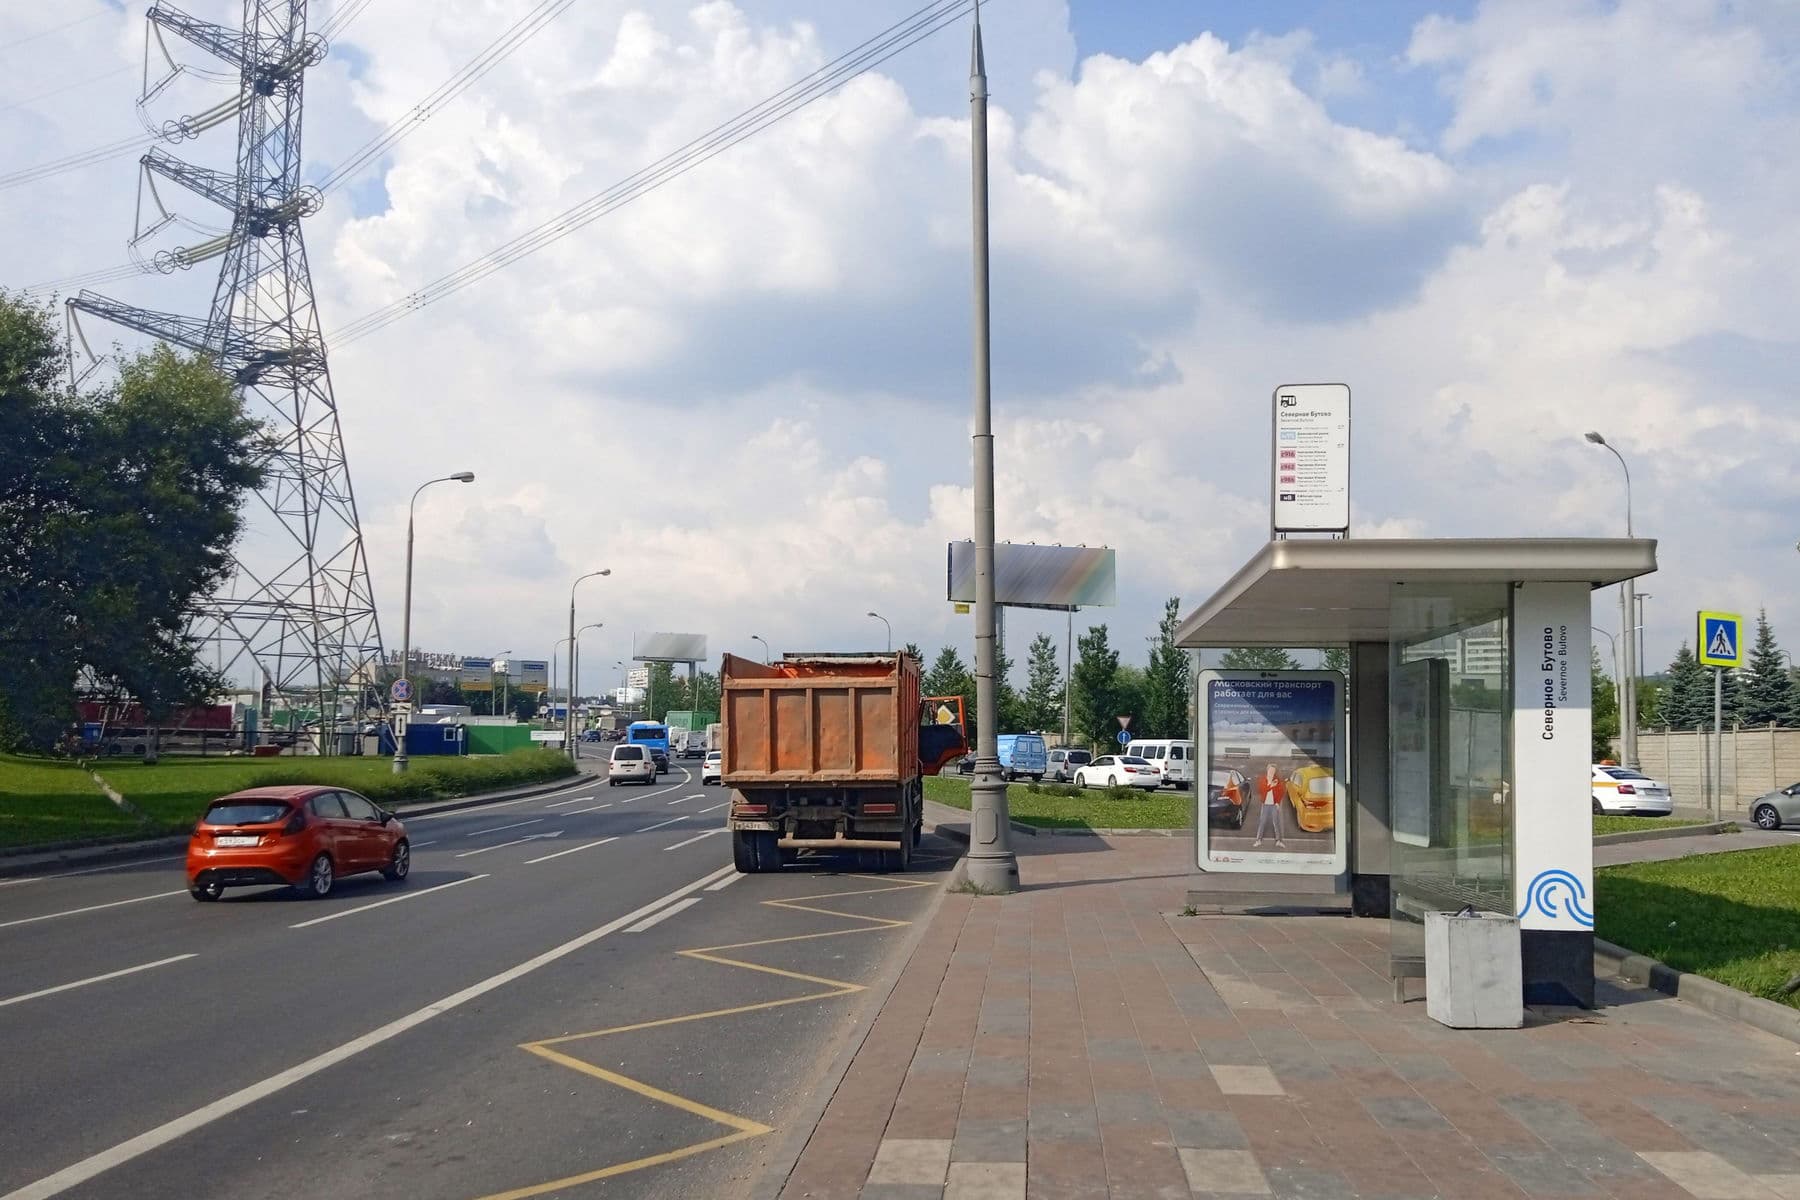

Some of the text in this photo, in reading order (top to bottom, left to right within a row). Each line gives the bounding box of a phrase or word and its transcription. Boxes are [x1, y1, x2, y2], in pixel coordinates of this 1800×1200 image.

[1541, 627, 1557, 741] Северное Бутово
[1558, 625, 1568, 702] Severnoe Butovo
[1214, 689, 1257, 699] работает
[1257, 691, 1275, 699] для
[1274, 682, 1322, 690] транспорт
